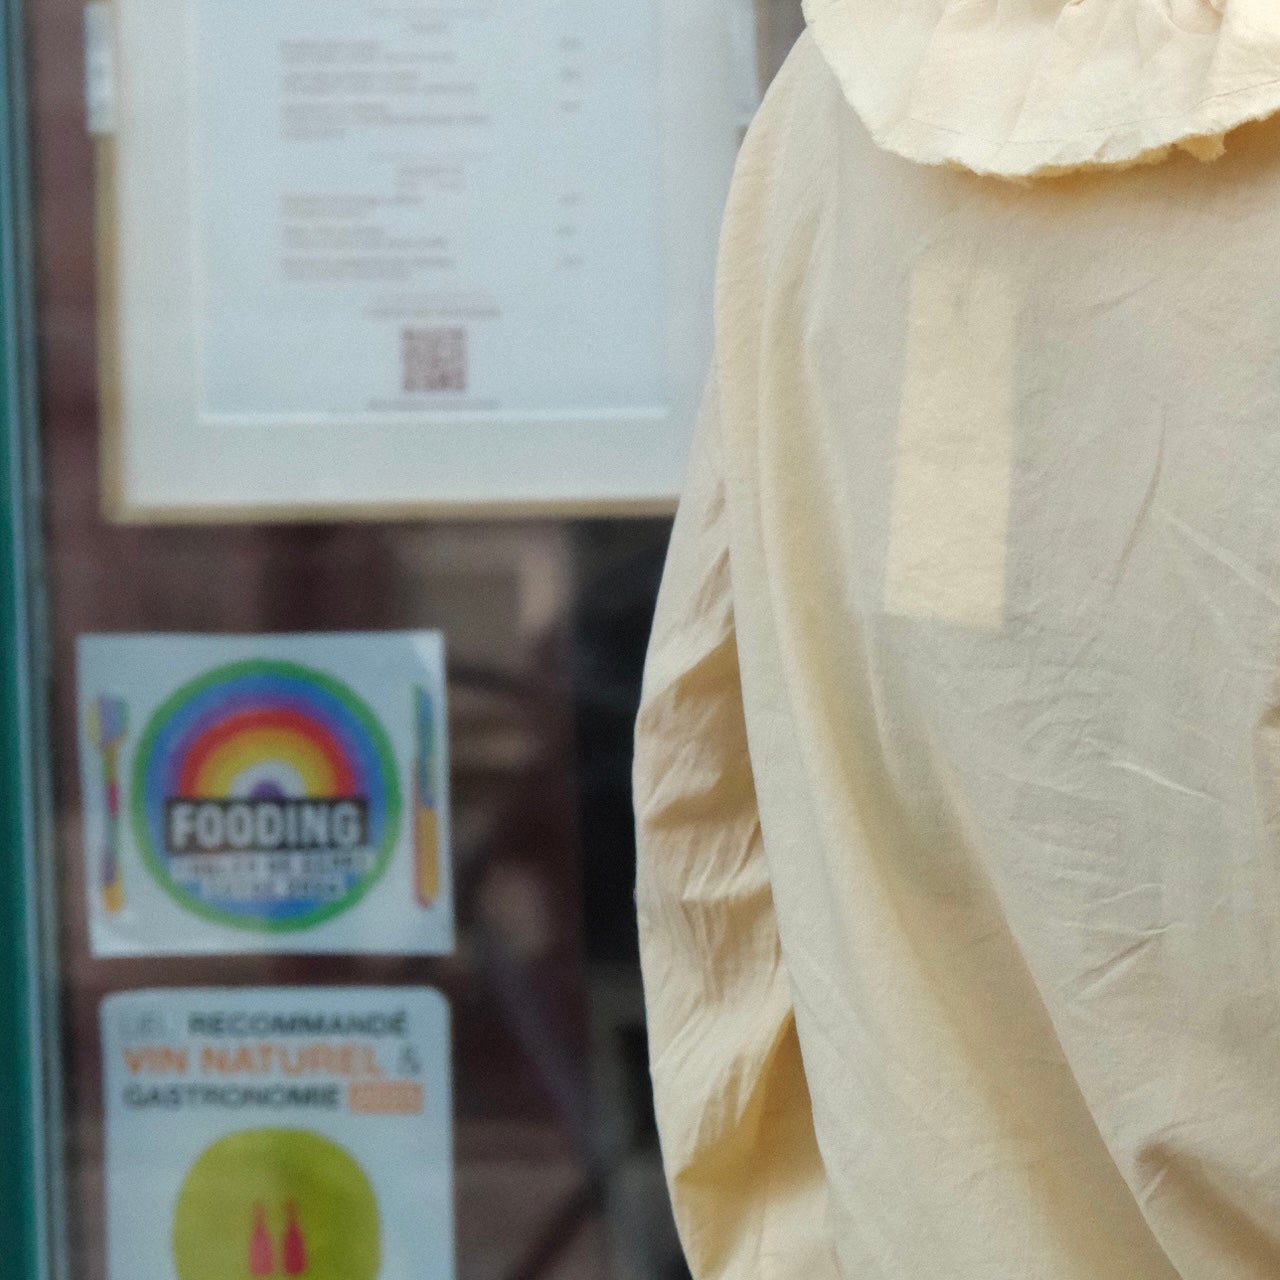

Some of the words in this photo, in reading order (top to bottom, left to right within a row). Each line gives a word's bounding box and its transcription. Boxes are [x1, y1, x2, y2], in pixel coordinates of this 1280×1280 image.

[170, 802, 361, 848] FOODING
[187, 1007, 408, 1038] RECOMMANDÉ
[123, 1045, 188, 1074] VIN
[200, 1043, 386, 1076] NATUREL
[122, 1083, 340, 1112] GASTRONOMIE
